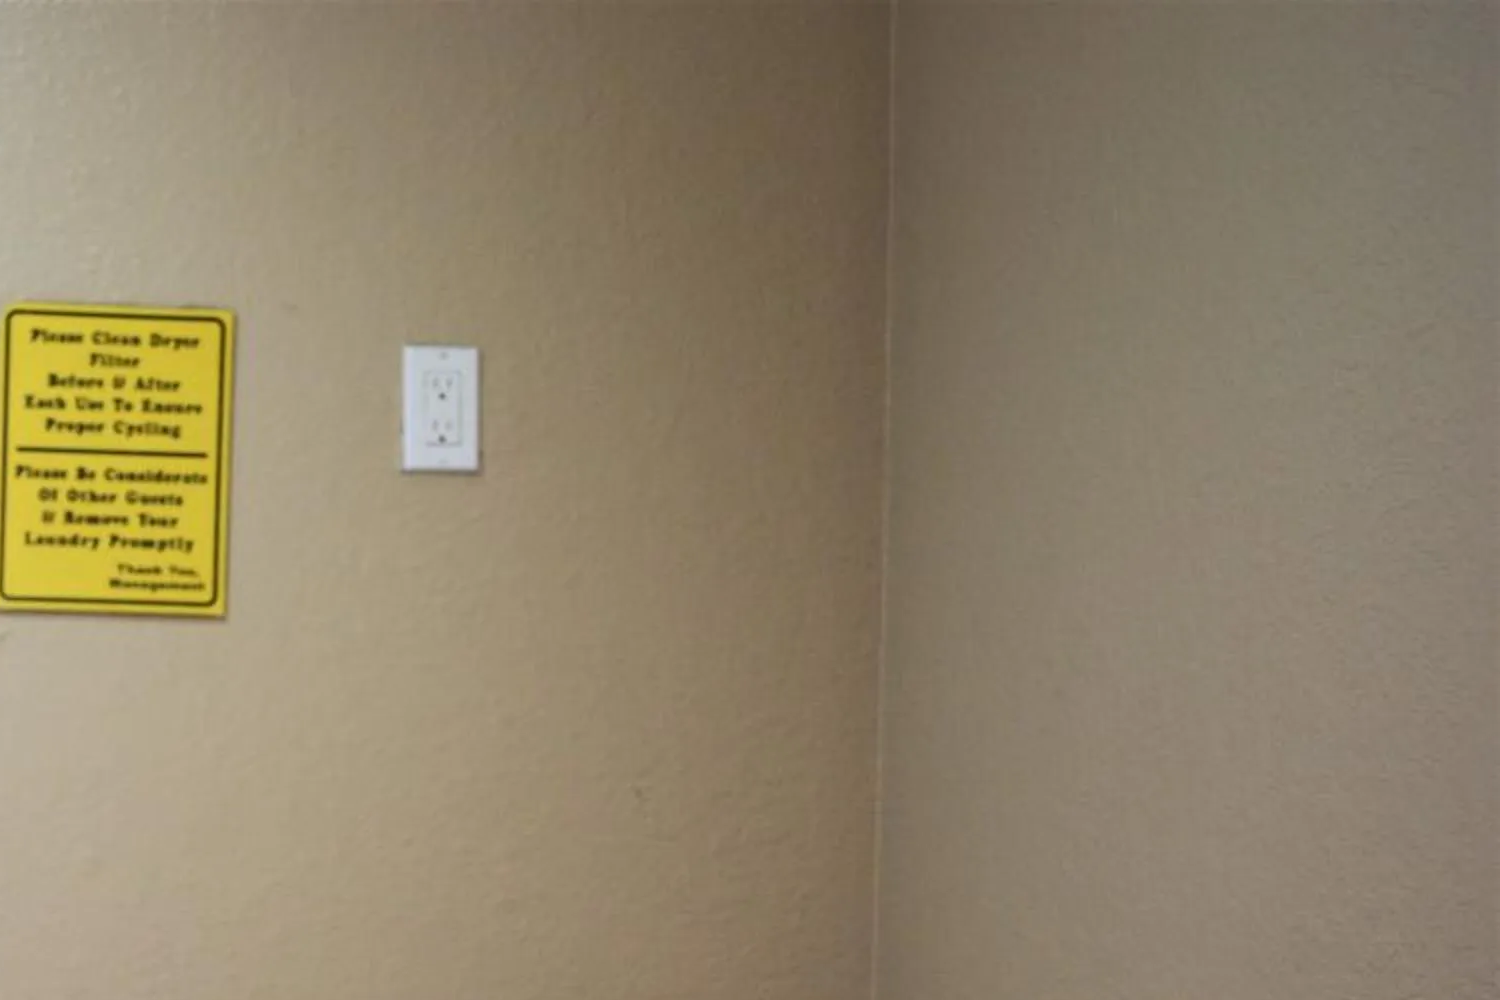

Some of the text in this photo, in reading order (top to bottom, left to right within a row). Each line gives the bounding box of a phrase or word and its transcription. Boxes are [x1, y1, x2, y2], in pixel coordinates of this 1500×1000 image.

[30, 329, 200, 351] Please Clean Dryer
[89, 352, 140, 368] Filter
[48, 373, 104, 389] Before
[135, 376, 181, 391] After
[24, 394, 203, 414] Each Use To Ensure
[45, 417, 181, 439] Proper Cycling
[15, 465, 208, 485] Please Be Considerate
[38, 488, 184, 506] Of Other Guests
[63, 510, 129, 526] Remove
[138, 513, 179, 529] Your
[24, 531, 194, 554] Laundry Promptly
[117, 562, 163, 576] Thank
